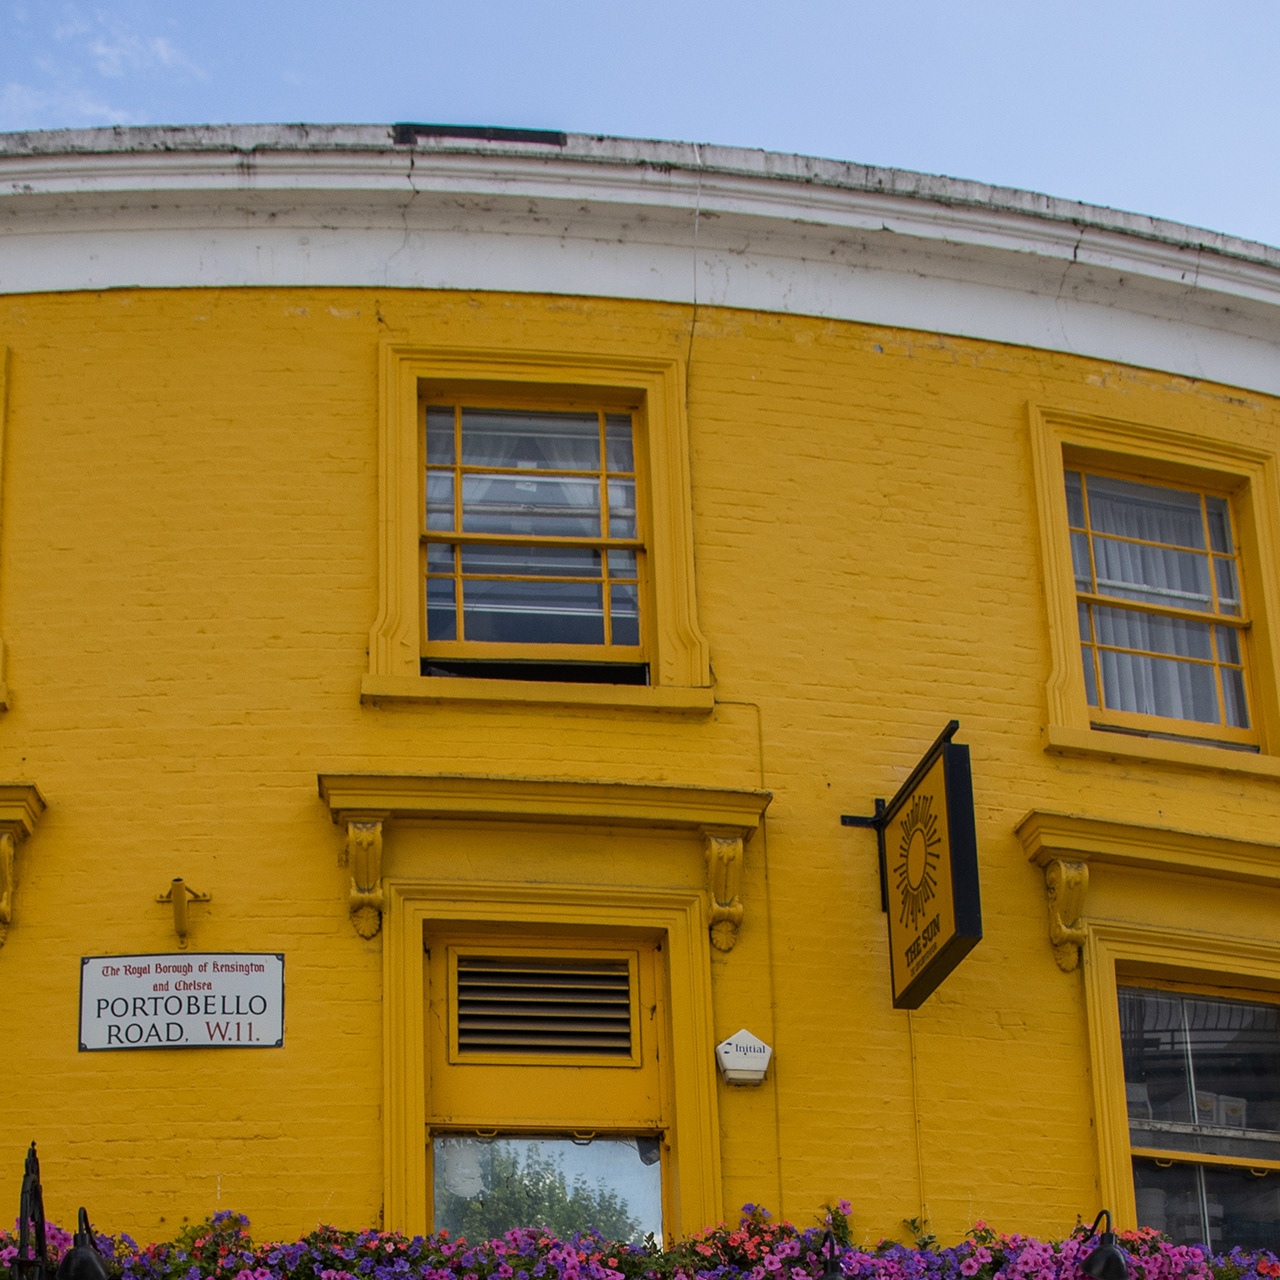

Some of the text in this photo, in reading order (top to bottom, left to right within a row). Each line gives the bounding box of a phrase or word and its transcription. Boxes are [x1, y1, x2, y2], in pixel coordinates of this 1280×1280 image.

[905, 935, 922, 968] THE
[922, 913, 940, 948] SUN
[101, 960, 265, 978] The Royal Borough of Kensington
[153, 980, 213, 992] and Chelsea
[96, 994, 268, 1018] PORTOBELLO
[107, 1021, 190, 1045] ROAD,
[735, 1043, 766, 1053] Initial
